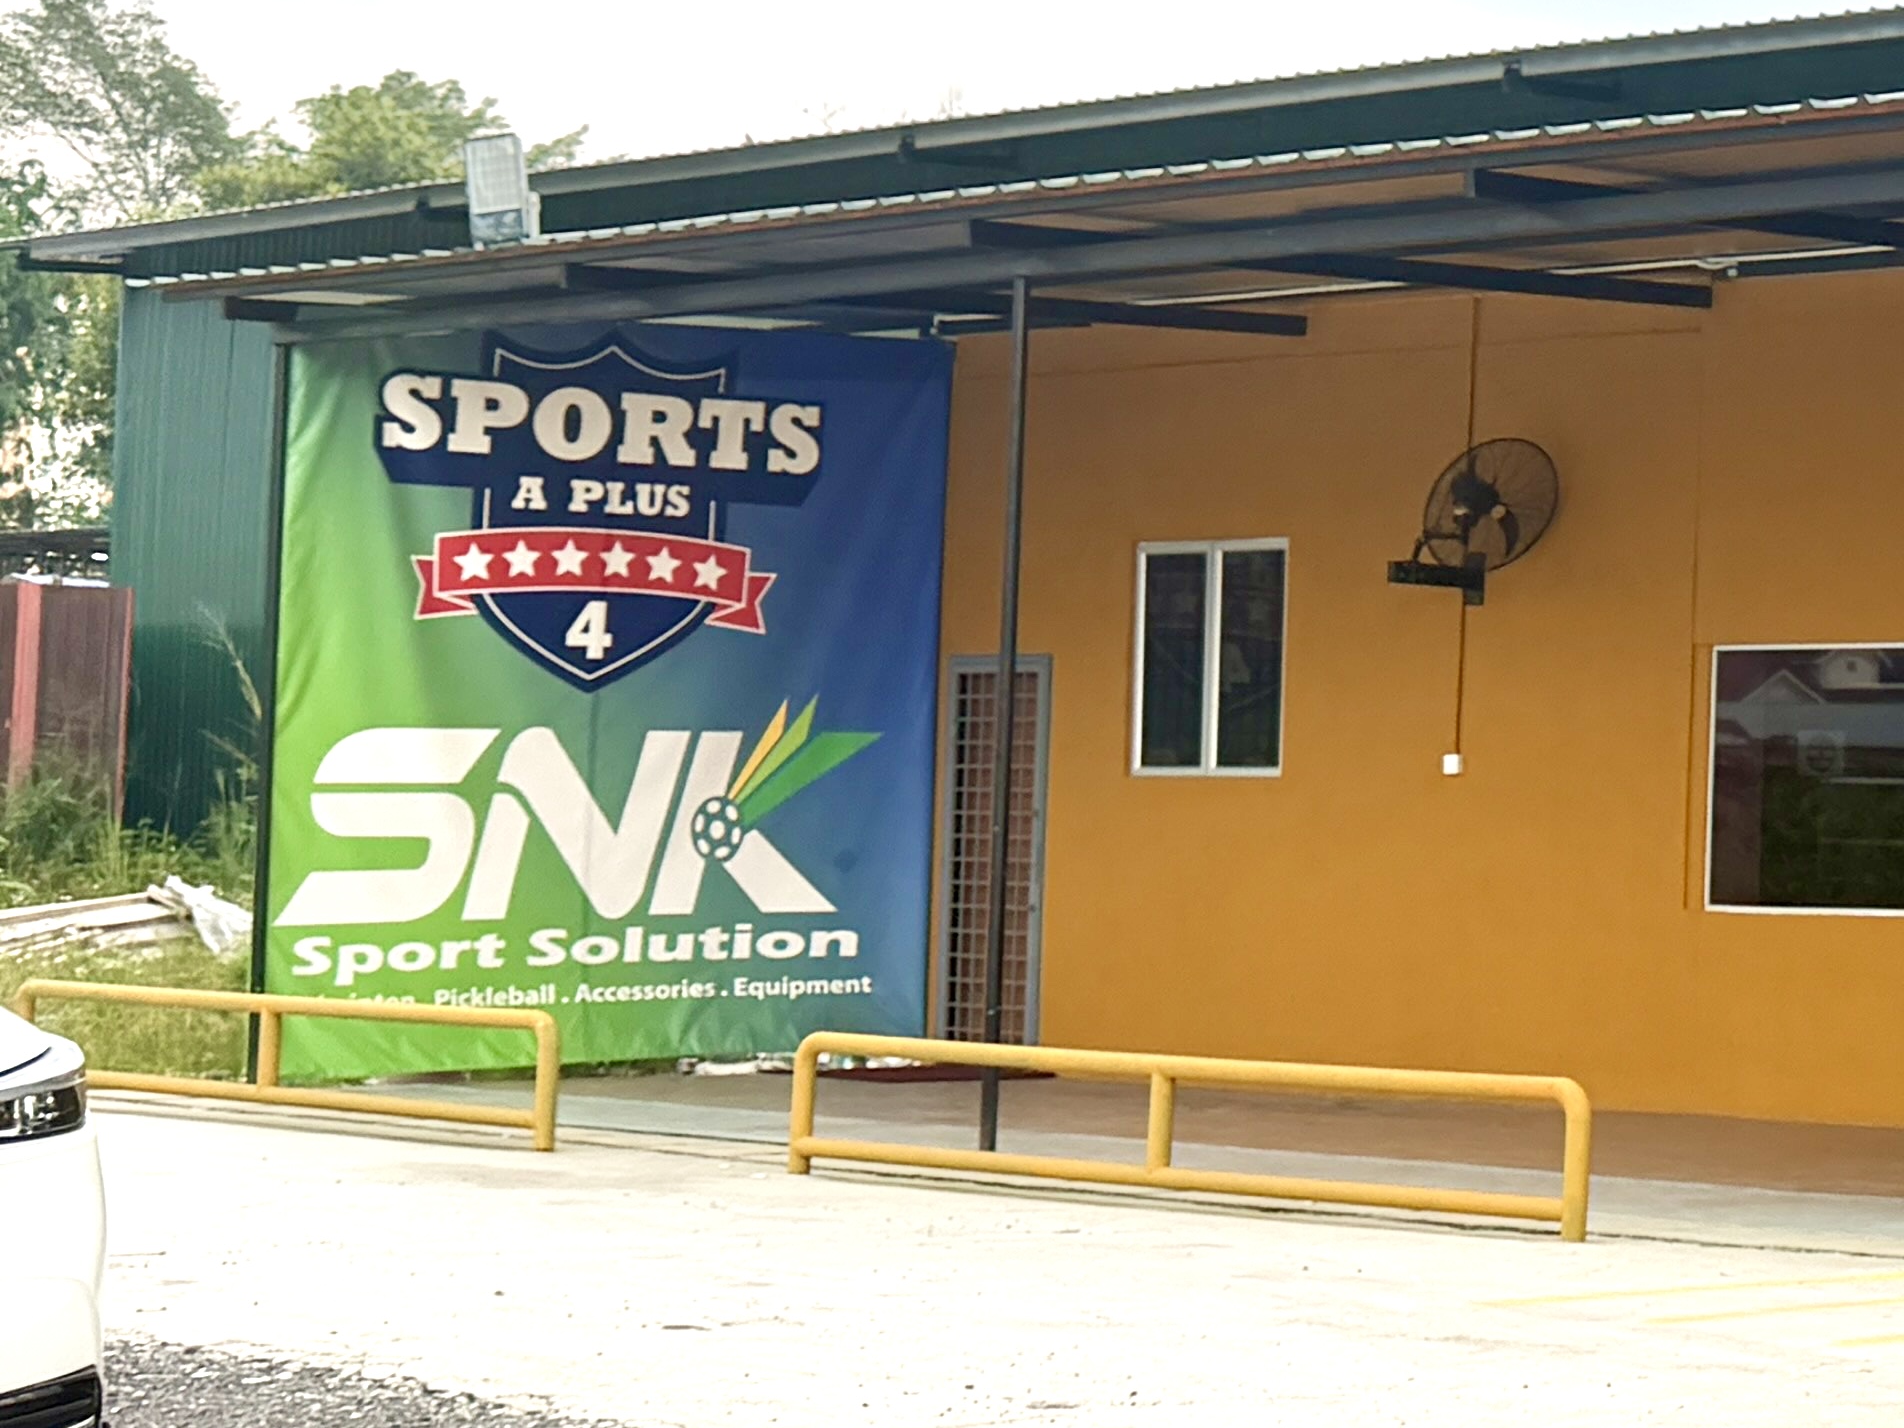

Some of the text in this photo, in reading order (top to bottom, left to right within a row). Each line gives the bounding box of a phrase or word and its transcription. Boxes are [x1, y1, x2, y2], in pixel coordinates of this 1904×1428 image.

[380, 375, 823, 475] SPORTS
[511, 476, 691, 517] A PLUS
[565, 600, 613, 660] 4
[273, 727, 838, 926] SNK
[292, 923, 861, 986] Sport Solution
[434, 983, 556, 1008] Pickleball
[574, 978, 716, 1004] Accessories
[733, 975, 873, 1002] Equipment
